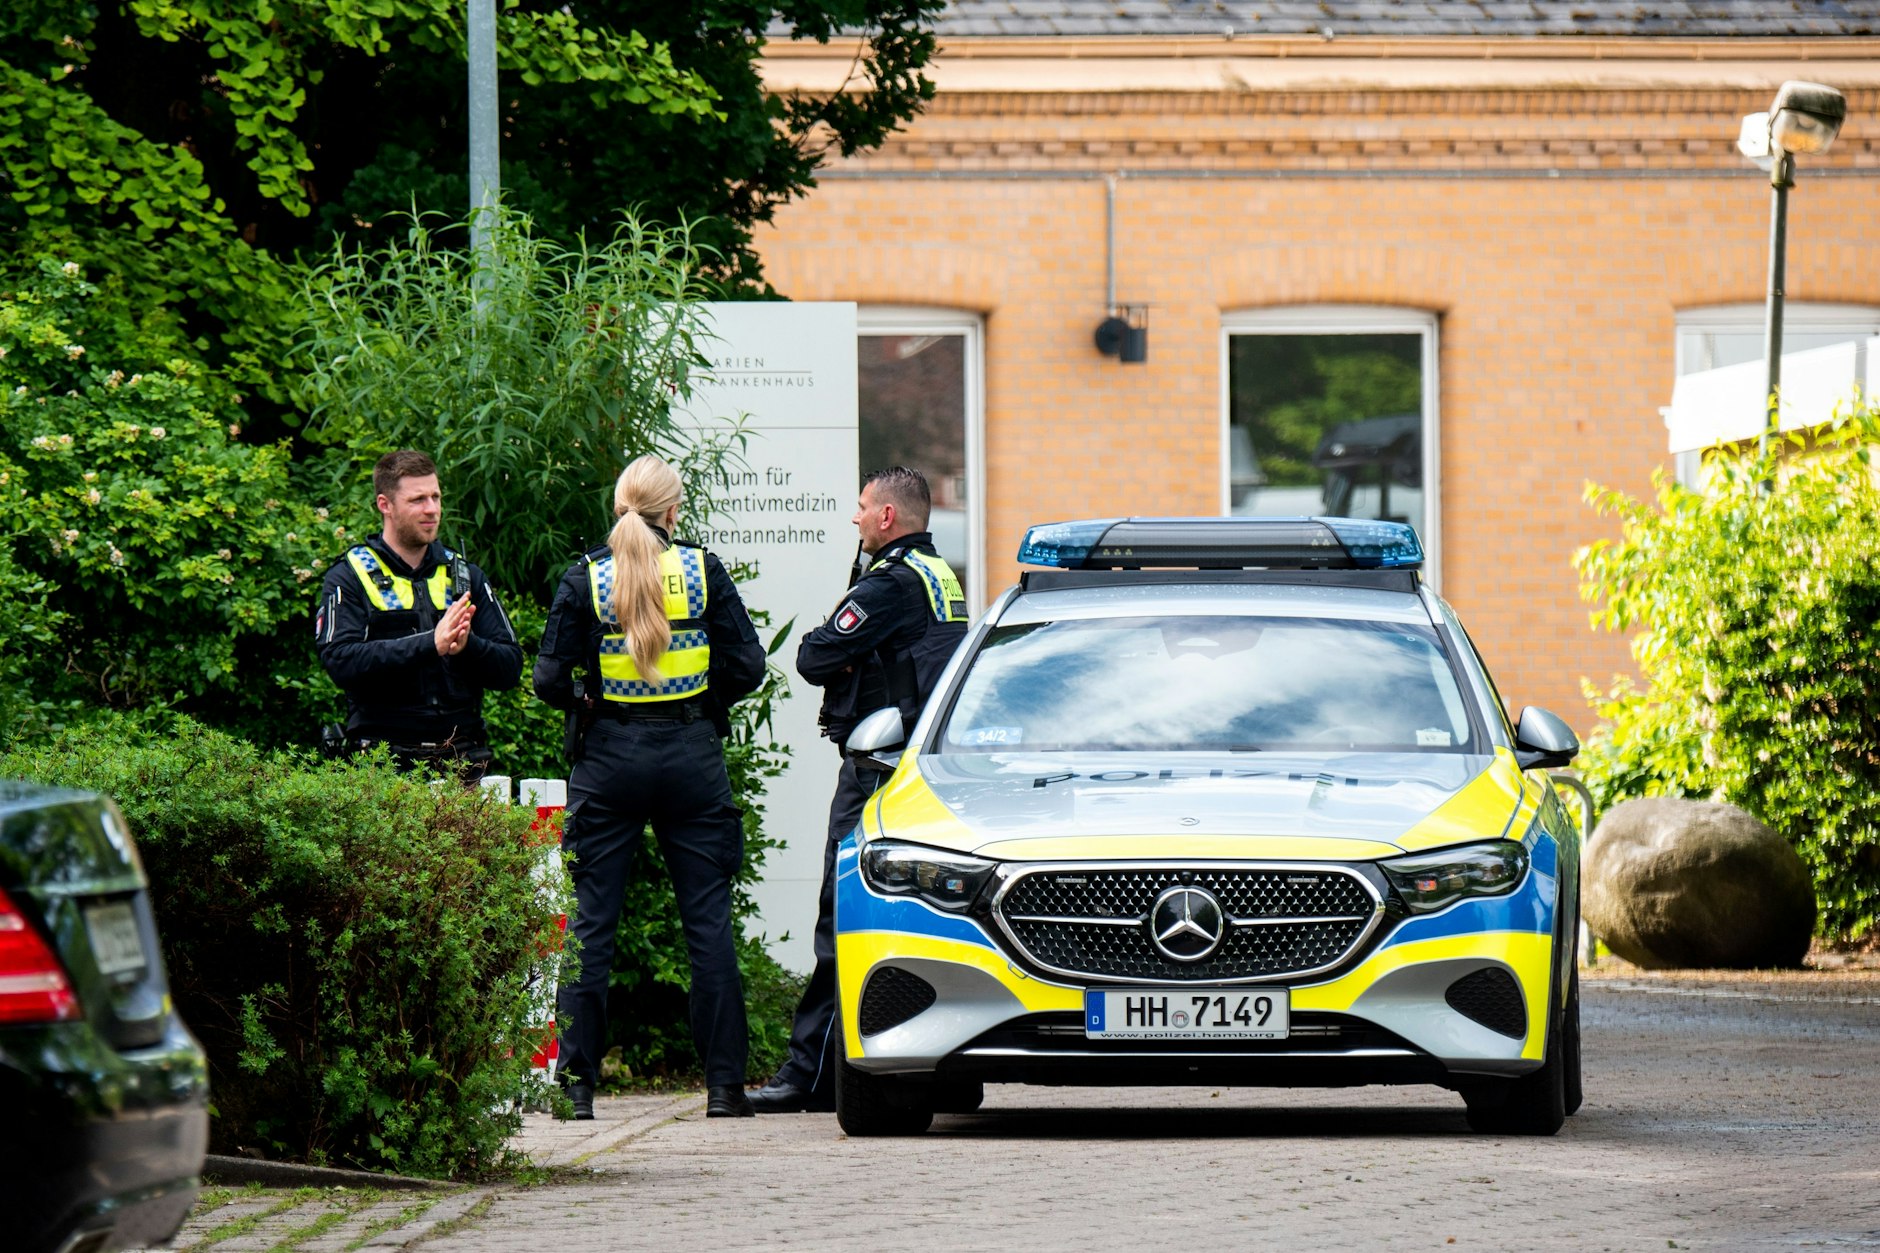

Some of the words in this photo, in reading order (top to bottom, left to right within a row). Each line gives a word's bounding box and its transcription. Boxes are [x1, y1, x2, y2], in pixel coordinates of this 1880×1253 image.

[713, 358, 765, 368] ARIEN
[766, 467, 792, 486] für
[976, 729, 1007, 743] 34/2
[1126, 996, 1168, 1026] HH
[1192, 996, 1273, 1027] 7149
[1092, 1016, 1099, 1025] D
